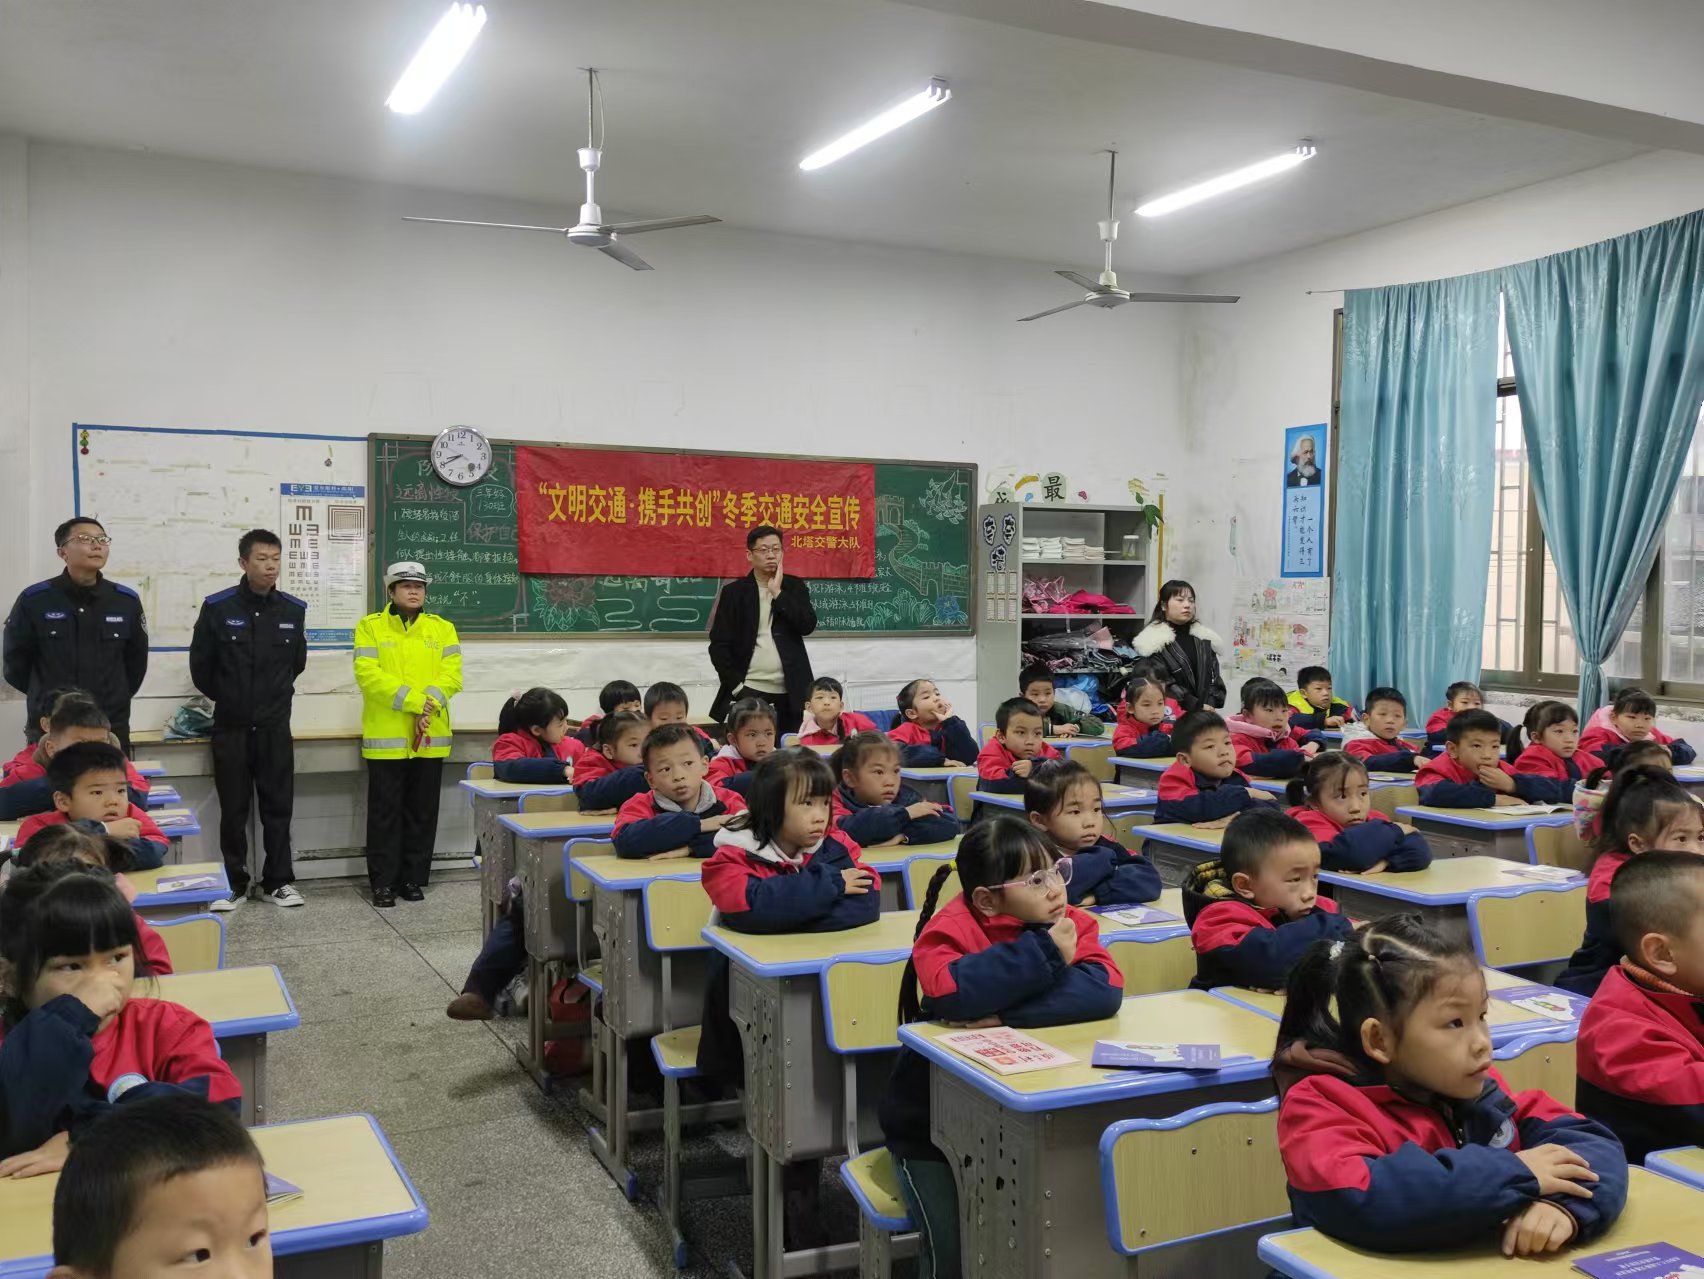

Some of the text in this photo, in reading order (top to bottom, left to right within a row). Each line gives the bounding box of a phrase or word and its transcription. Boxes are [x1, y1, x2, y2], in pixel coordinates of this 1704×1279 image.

[457, 431, 466, 439] 12
[481, 452, 486, 460] 3
[448, 469, 453, 477] 7
[458, 472, 463, 480] 6
[1044, 475, 1065, 501] 最
[791, 536, 861, 550] 北塔交警大队
